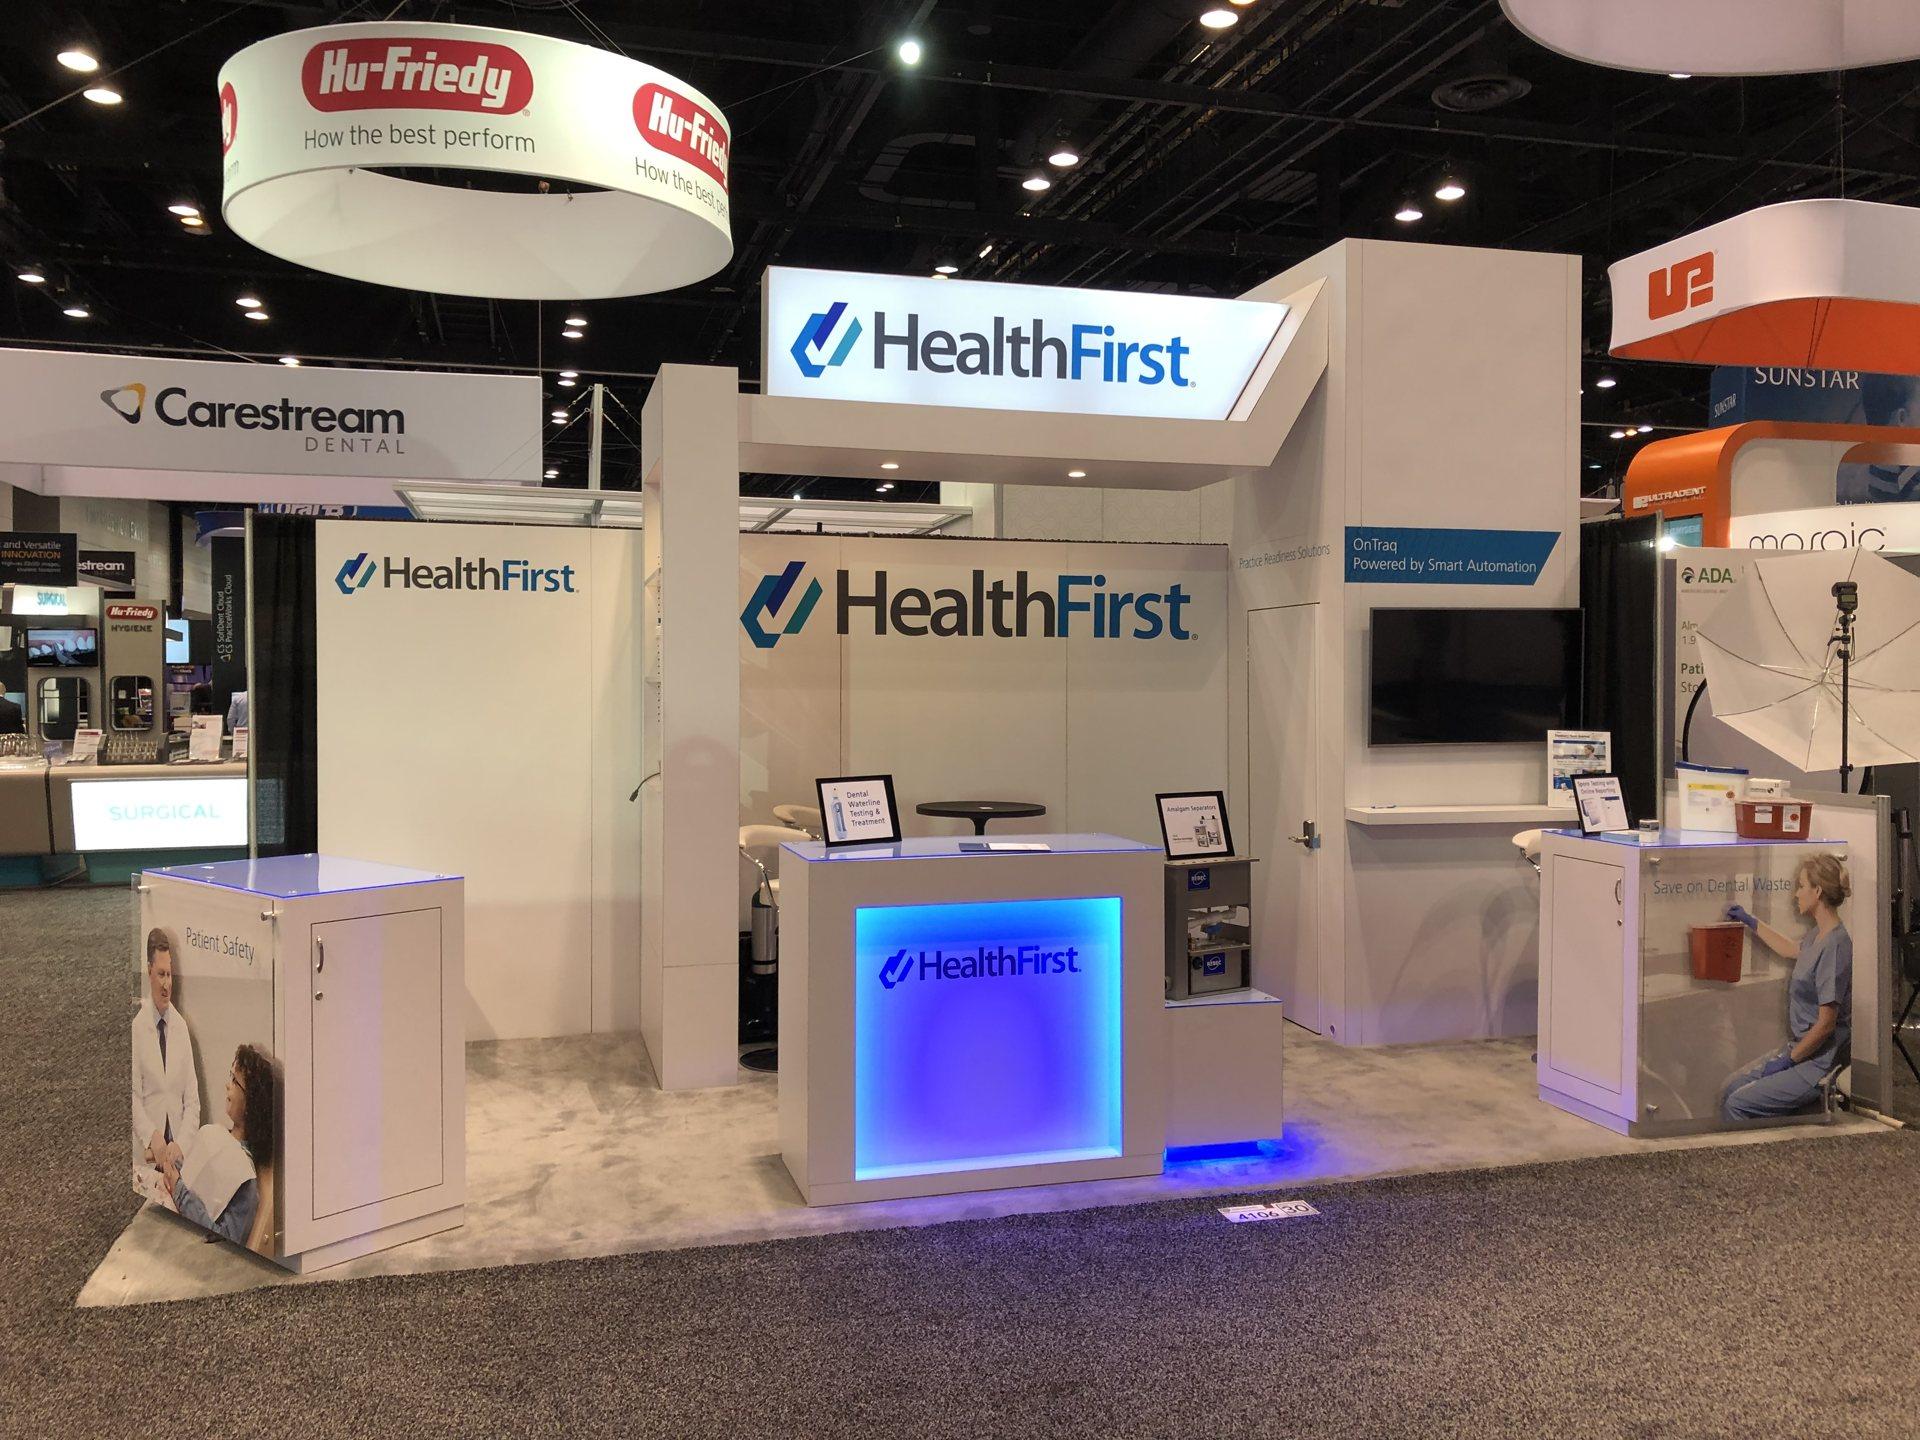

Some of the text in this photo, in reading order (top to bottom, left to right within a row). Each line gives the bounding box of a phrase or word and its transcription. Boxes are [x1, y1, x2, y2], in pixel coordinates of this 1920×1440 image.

[318, 46, 512, 108] Hu-Friedy
[304, 123, 537, 154] How the best perform
[635, 156, 669, 185] How
[672, 170, 693, 196] the
[695, 181, 715, 209] best
[874, 311, 1190, 388] HealthFirst
[154, 387, 406, 434] Carestream
[1714, 393, 1737, 418] SUNSTAR
[304, 436, 406, 455] DENTAL
[1648, 486, 1707, 502] ULTRADENT
[3, 541, 61, 549] and Versatile
[1353, 538, 1398, 554] OnTraq
[0, 551, 61, 559] INNOVATION
[1239, 544, 1330, 569] Practice Readiness Solutions
[383, 556, 575, 593] HealthFirst
[1353, 557, 1537, 574] Powered by Smart Automation
[224, 574, 232, 594] Cloud
[1697, 568, 1734, 584] ADA
[216, 590, 224, 611] Cloud
[836, 569, 1191, 640] HealthFirst
[110, 606, 154, 618] Hu-Friedy
[110, 624, 153, 632] HYGIENE
[847, 790, 869, 799] Dental
[848, 799, 881, 808] Waterline
[109, 803, 222, 821] SURGICAL
[850, 808, 881, 818] Testing &
[1167, 804, 1217, 813] Amalgam Separators
[851, 817, 886, 827] Treatment
[1654, 876, 1792, 895] Save on Dental Waste
[186, 926, 255, 966] Patient Safety
[919, 945, 1079, 981] HealthFirst
[1239, 1210, 1280, 1221] 4106
[1282, 1204, 1310, 1214] 30
